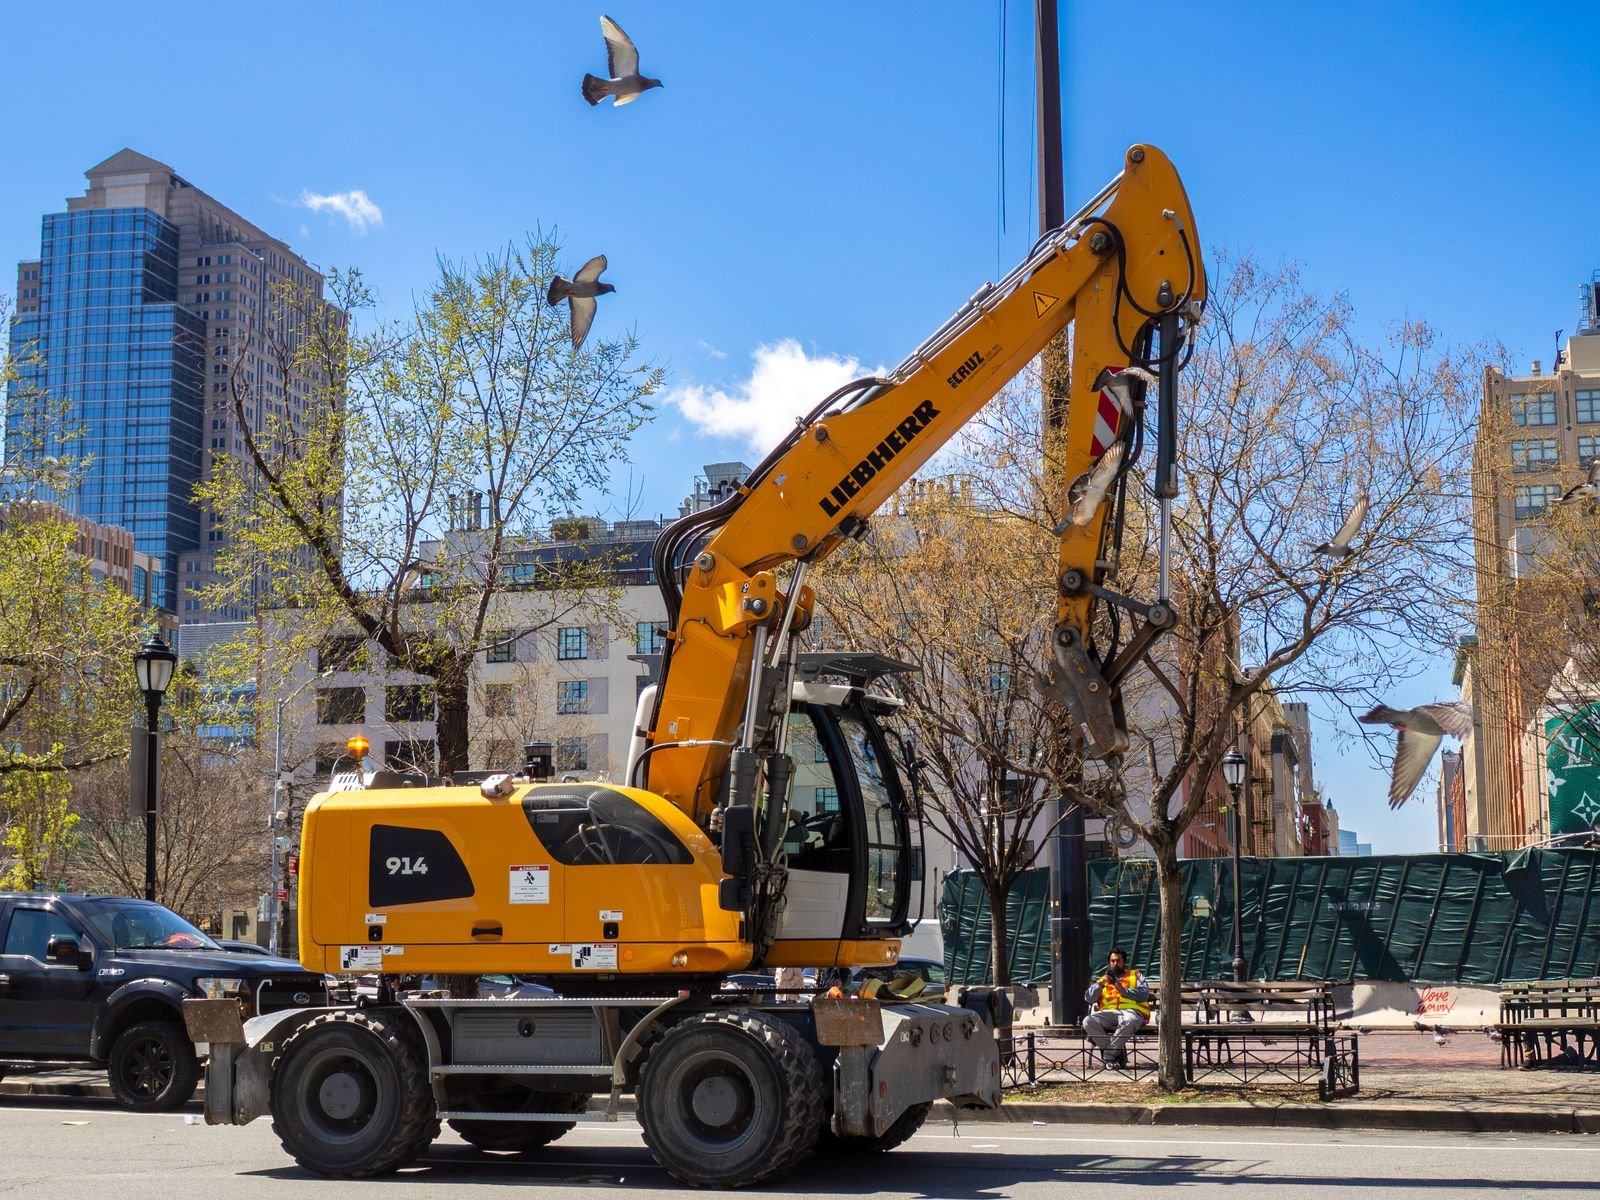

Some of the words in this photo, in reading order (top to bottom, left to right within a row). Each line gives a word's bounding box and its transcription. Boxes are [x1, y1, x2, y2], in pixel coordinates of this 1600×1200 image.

[818, 400, 941, 518] LIEBHERR
[386, 856, 428, 875] 914
[1418, 984, 1449, 1004] love
